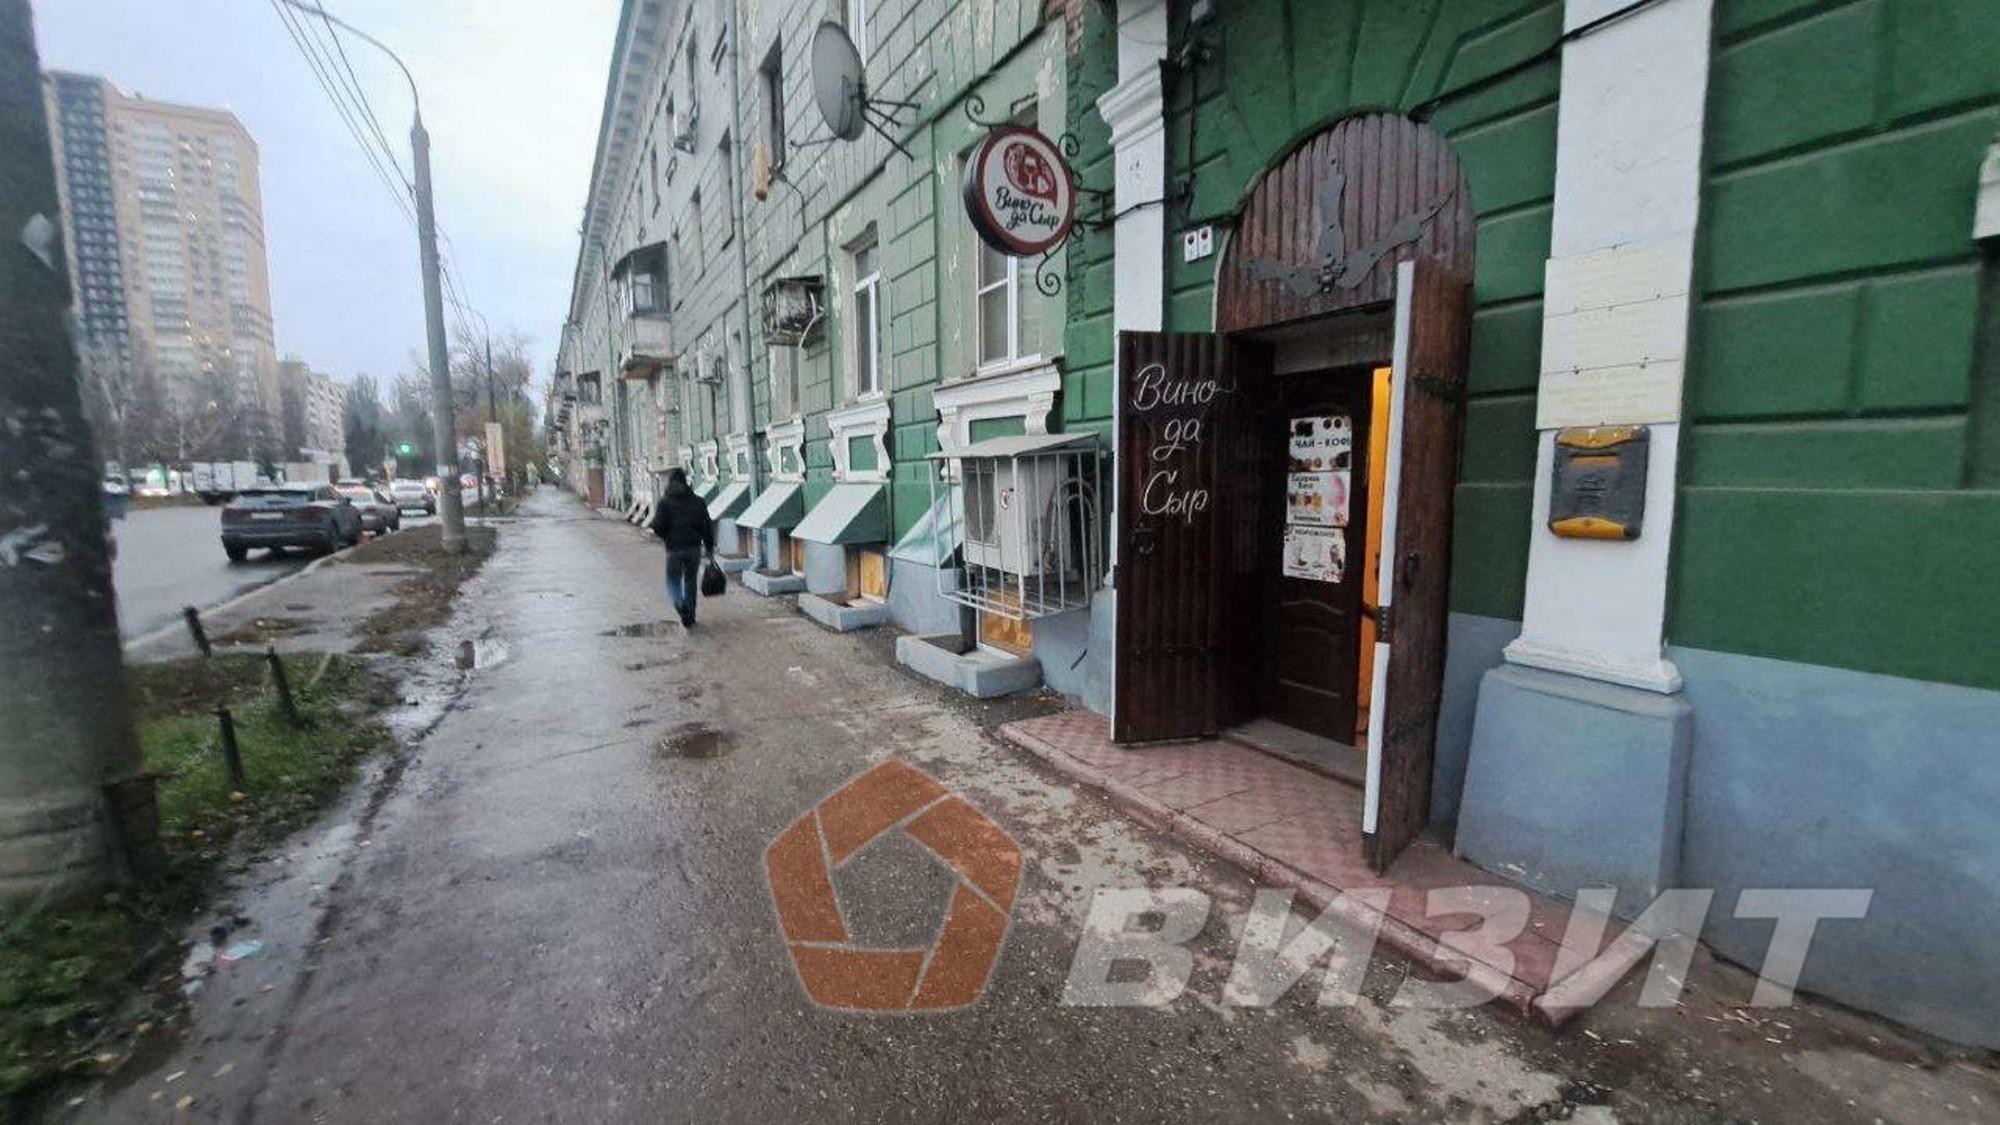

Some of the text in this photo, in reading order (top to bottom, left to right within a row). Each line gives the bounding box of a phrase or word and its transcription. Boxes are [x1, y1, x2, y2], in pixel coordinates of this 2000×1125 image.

[995, 186, 1031, 210] Вино
[1030, 202, 1060, 232] Сыр
[1134, 363, 1237, 411] Вино
[1152, 418, 1201, 461] да
[1143, 470, 1209, 523] Сыр
